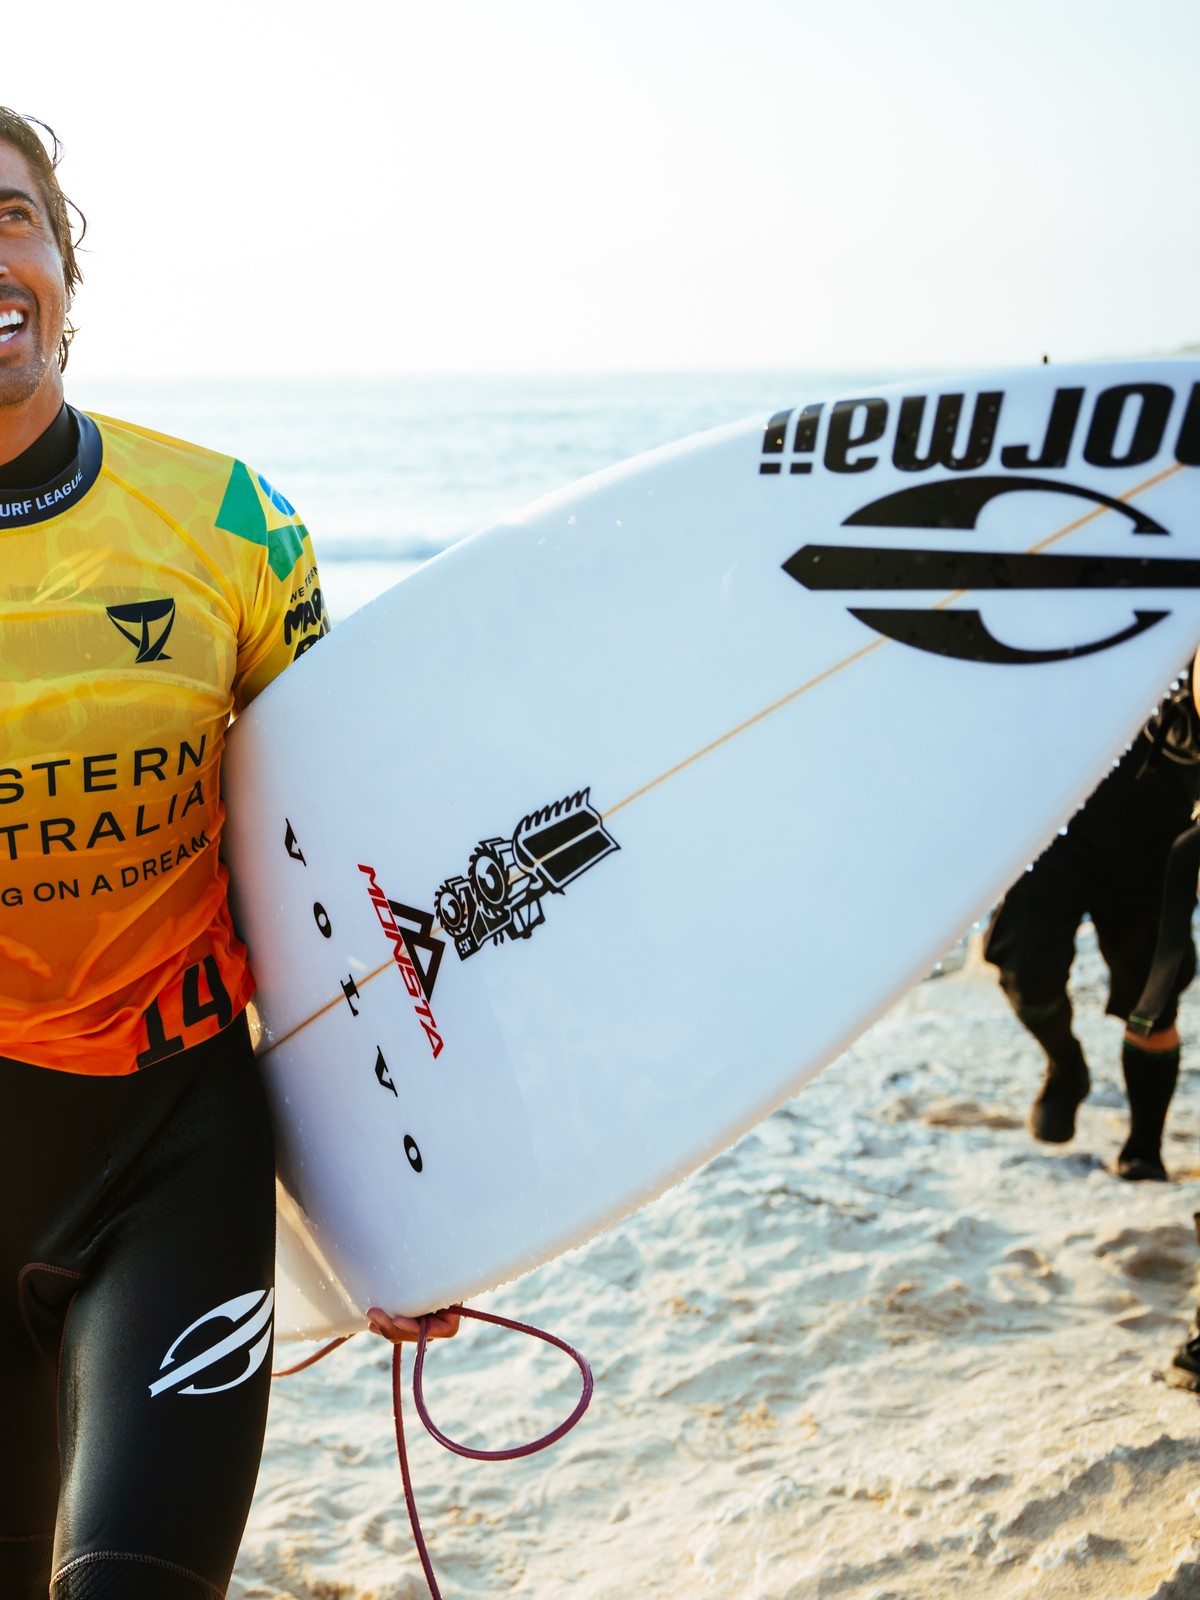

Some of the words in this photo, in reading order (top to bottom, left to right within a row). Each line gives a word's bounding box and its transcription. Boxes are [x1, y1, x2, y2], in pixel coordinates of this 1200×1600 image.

[759, 381, 1200, 474] ormaii
[35, 468, 83, 511] LEAGUE
[33, 879, 80, 902] ON
[90, 874, 113, 896] A
[120, 830, 211, 889] DREAM
[136, 954, 232, 1069] 14
[284, 818, 423, 1173] VOLVO
[357, 864, 444, 1059] MONSTA
